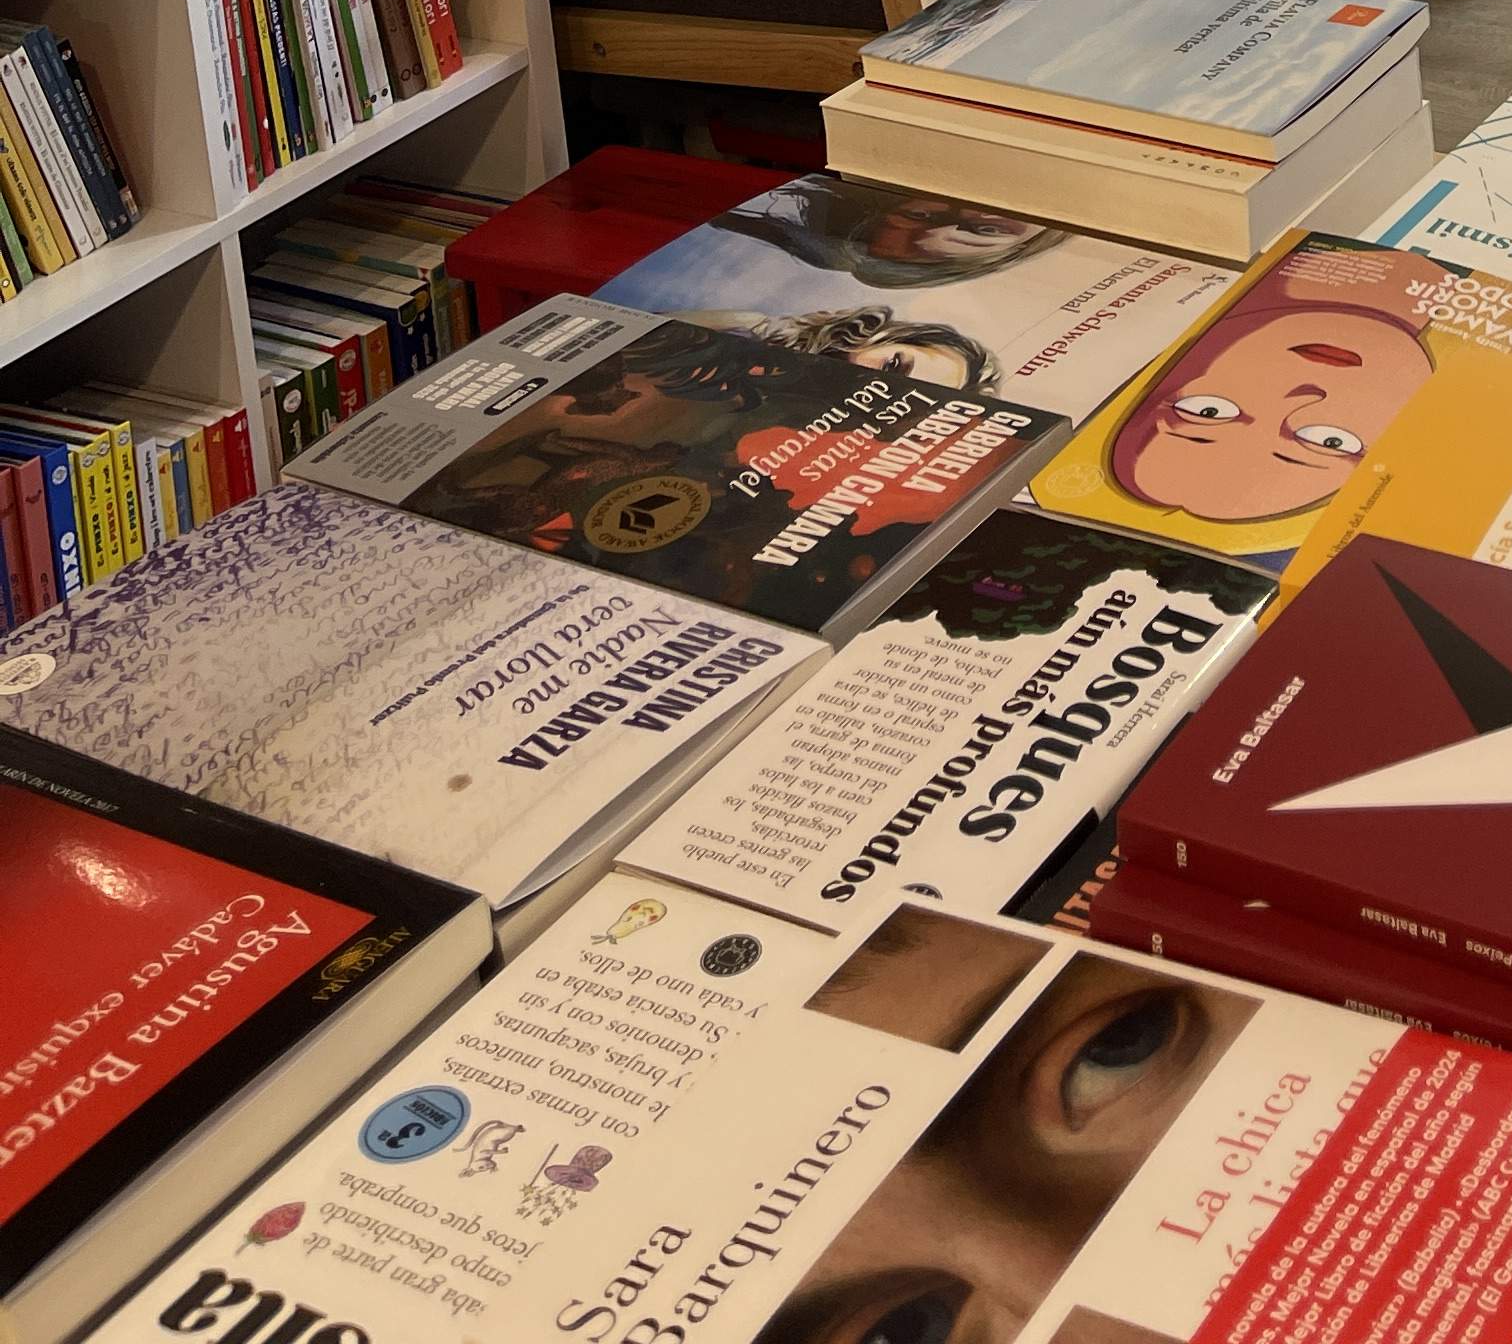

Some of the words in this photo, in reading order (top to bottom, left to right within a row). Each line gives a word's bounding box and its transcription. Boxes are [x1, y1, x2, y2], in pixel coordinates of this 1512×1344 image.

[1172, 17, 1219, 56] veritat
[1239, 12, 1258, 29] de
[1199, 30, 1271, 81] COMPANY
[1092, 267, 1138, 293] buen
[1108, 263, 1192, 310] Samanta
[1136, 257, 1160, 270] El
[1059, 290, 1096, 314] mal
[1405, 279, 1507, 320] MORIR
[1015, 310, 1117, 378] Schweblin
[843, 378, 895, 413] del
[874, 388, 940, 426] Las
[728, 404, 850, 500] naranjel
[798, 422, 881, 484] niñas
[859, 399, 986, 480] CABEZÓN
[901, 410, 1032, 494] GABRIELA
[751, 474, 877, 568] CÁMARA
[554, 594, 634, 650] verá
[568, 606, 684, 676] Nadie
[1074, 589, 1138, 650] aún
[456, 642, 565, 718] llorar
[603, 620, 737, 694] RIVERA
[1000, 648, 1080, 717] más
[511, 673, 571, 715] me
[620, 636, 784, 734] CRISTINA
[496, 691, 629, 771] GARZA
[958, 603, 1224, 844] Bosques
[1106, 689, 1159, 750] Herrera
[1211, 741, 1253, 788] Eva
[1240, 674, 1308, 755] Baltasar
[818, 711, 1015, 906] profundos
[682, 843, 739, 865] pueblo
[735, 860, 767, 875] este
[769, 870, 795, 888] En
[1173, 839, 1190, 870] 150
[128, 892, 265, 991] Cadáver
[1357, 904, 1421, 937] Baltasar
[1418, 923, 1450, 946] Eva
[125, 909, 314, 1048] Agustina
[534, 966, 561, 984] en
[558, 974, 623, 1004] estaba
[625, 994, 697, 1029] esencia
[699, 1019, 729, 1044] Su
[442, 1056, 525, 1098] extrañas,
[525, 1088, 600, 1128] formas
[600, 1113, 640, 1140] con
[1156, 1185, 1232, 1246] La
[1217, 1070, 1312, 1179] chica
[609, 1084, 891, 1344] Barquinero
[1226, 1282, 1278, 1344] novela
[1268, 1253, 1295, 1283] de
[1286, 1234, 1309, 1258] la
[1300, 1174, 1349, 1236] autora
[1341, 1140, 1368, 1176] del
[1357, 1066, 1423, 1149] fenómeno
[554, 1224, 693, 1343] Sara
